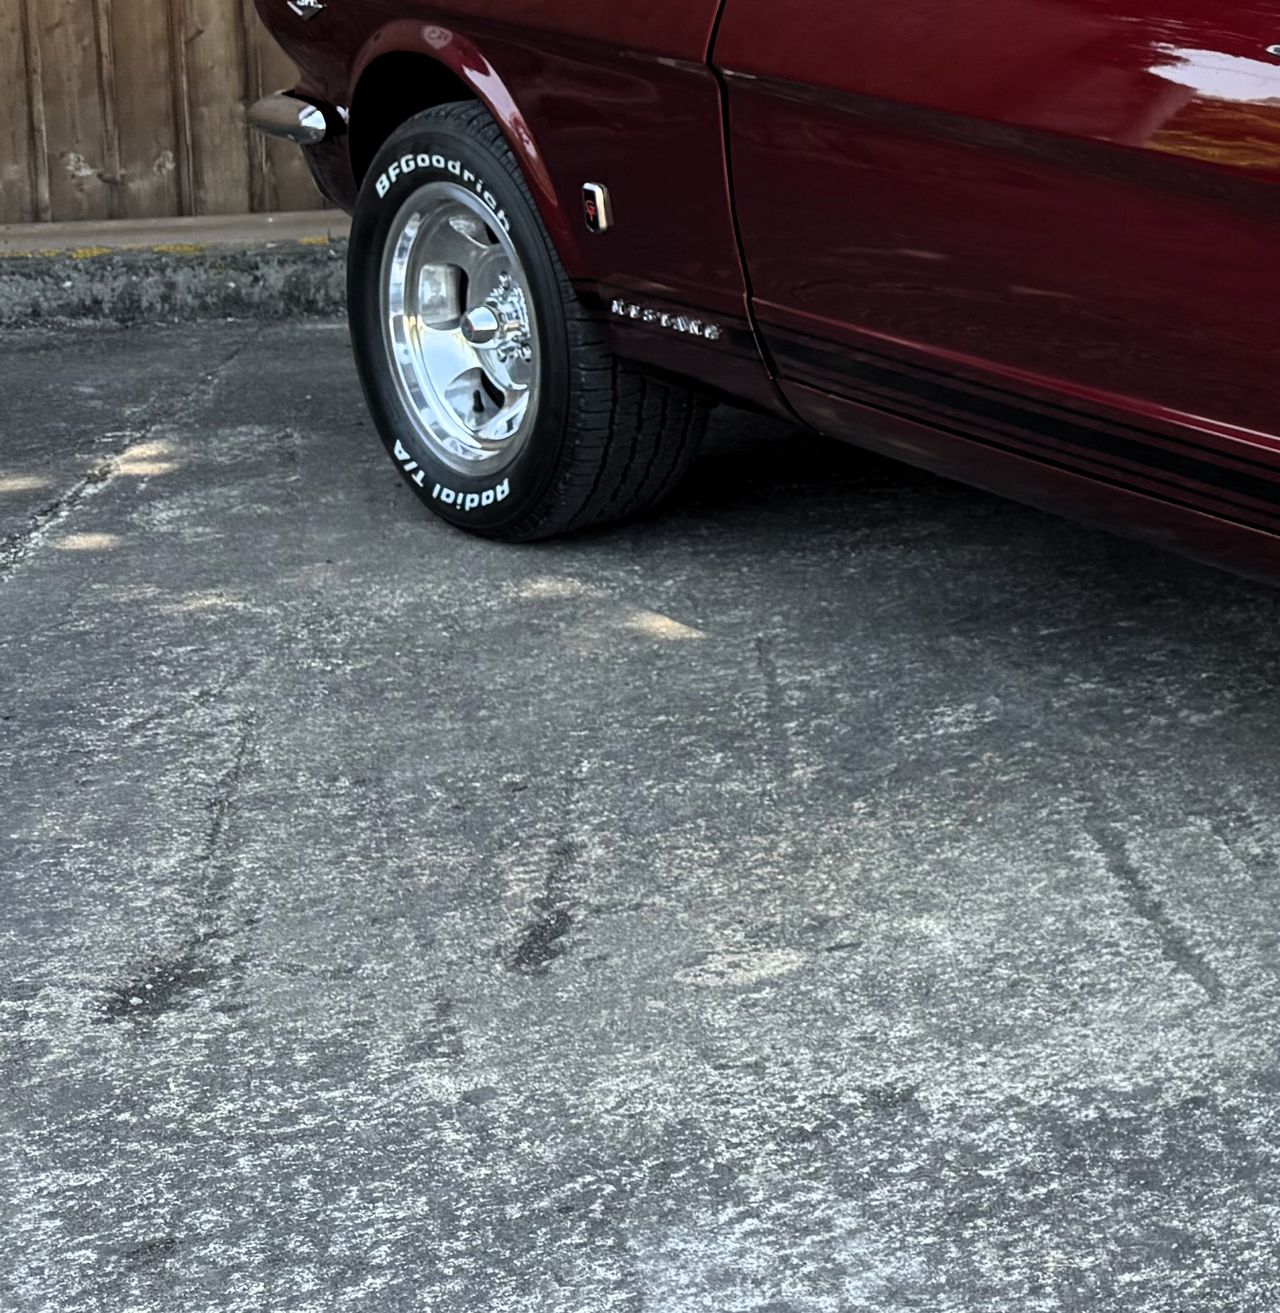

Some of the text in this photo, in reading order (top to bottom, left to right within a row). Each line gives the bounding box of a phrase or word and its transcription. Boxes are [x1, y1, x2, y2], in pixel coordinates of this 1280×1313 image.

[375, 153, 511, 232] BFGoodrich
[393, 439, 511, 512] Radial T/A
